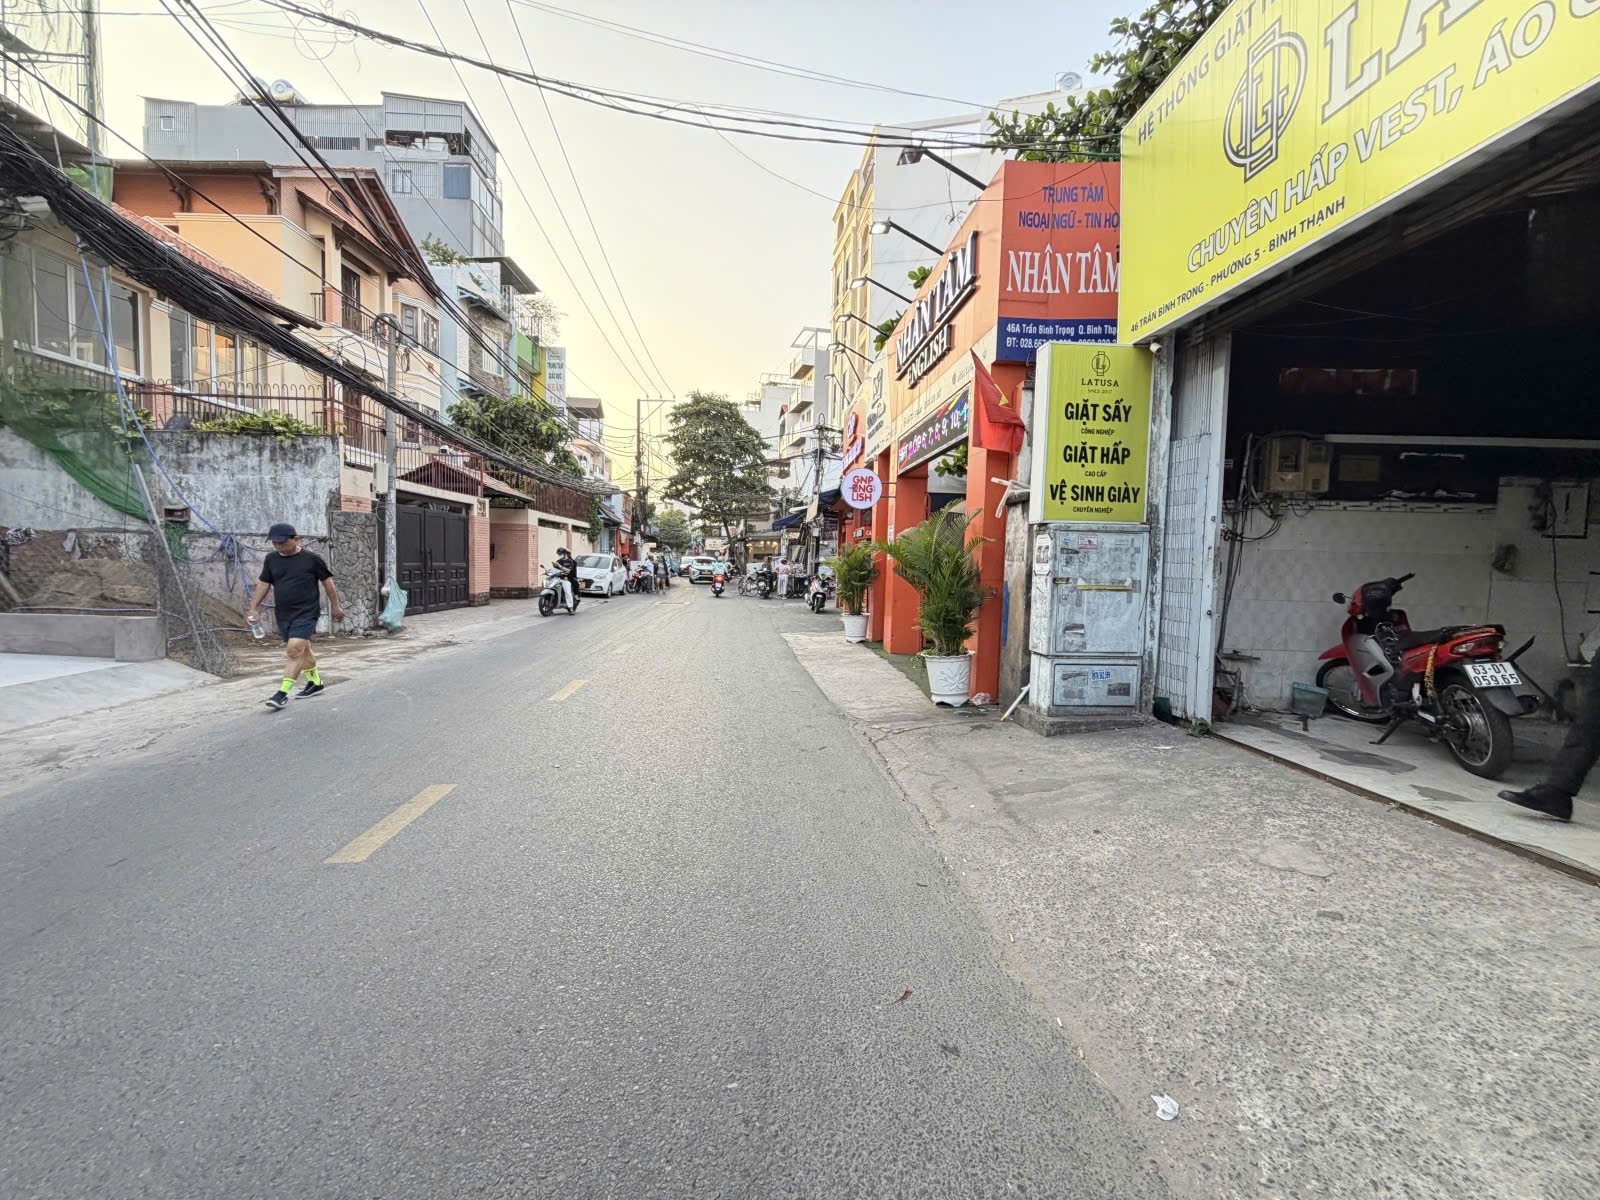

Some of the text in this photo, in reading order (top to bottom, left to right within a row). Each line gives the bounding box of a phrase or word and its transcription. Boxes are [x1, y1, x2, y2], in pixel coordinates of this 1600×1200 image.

[1139, 110, 1155, 145] HỆ
[1187, 0, 1556, 273] CHUYÊN HẤP VEST, ÁO
[1042, 182, 1104, 203] TRUNG TÂM
[1018, 211, 1050, 232] NGOẠI
[1052, 209, 1077, 230] NGỮ
[1084, 212, 1102, 229] TIN
[1006, 242, 1120, 294] NHÂN TÂM
[1130, 322, 1139, 333] 46
[1177, 281, 1205, 305] TRỌNG
[1211, 253, 1252, 287] PHƯỜNG
[1269, 225, 1297, 253] BÌNH
[1300, 196, 1346, 233] THẠNH
[896, 289, 934, 373] NHÂN
[934, 230, 978, 322] TÂM
[1006, 323, 1020, 333] 46A
[1038, 324, 1054, 335] Bình
[1055, 325, 1075, 336] Trọng
[1087, 324, 1103, 335] Bình
[1006, 337, 1019, 348] ĐT:
[908, 324, 951, 389] ENGLISH
[1081, 377, 1119, 387] LATUSA
[1065, 398, 1132, 425] GIẶT SẤY
[1063, 440, 1131, 468] GIẶT HẤP
[852, 475, 874, 484] GNP
[1050, 479, 1141, 505] VỆ SINH GIÀY
[851, 492, 872, 502] LISH
[1473, 673, 1519, 686] 059.65
